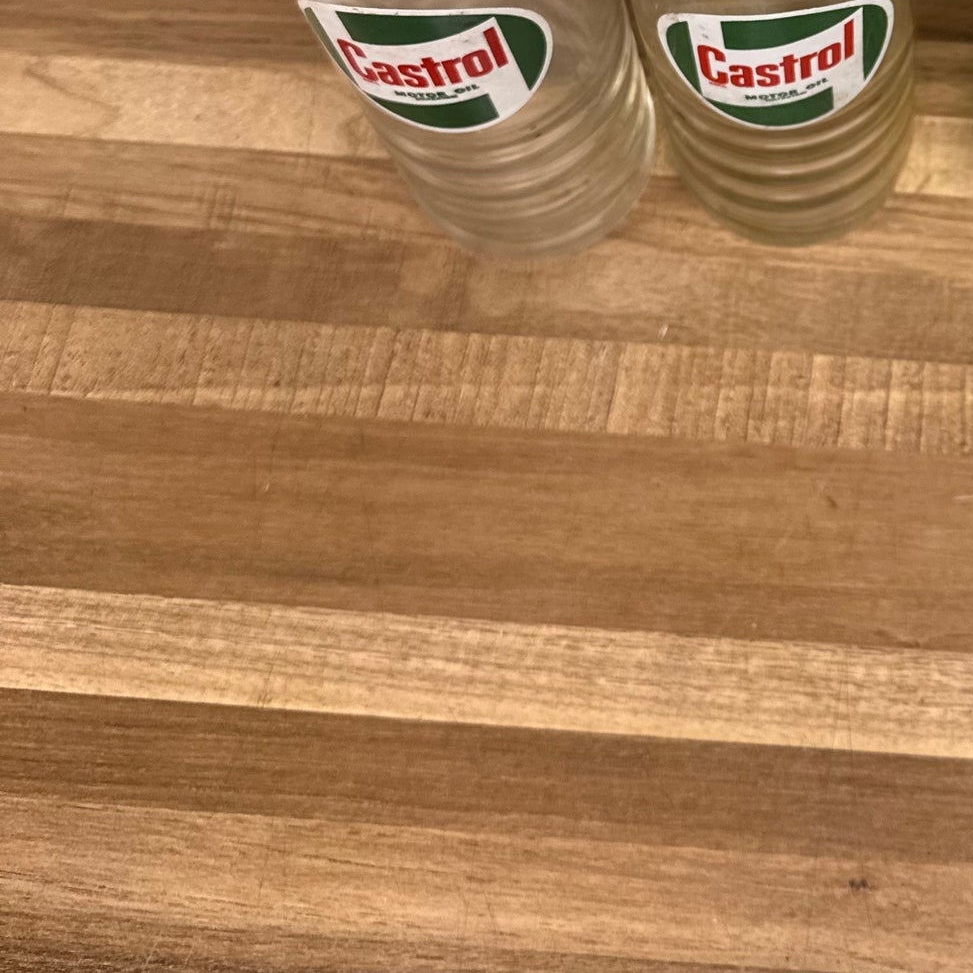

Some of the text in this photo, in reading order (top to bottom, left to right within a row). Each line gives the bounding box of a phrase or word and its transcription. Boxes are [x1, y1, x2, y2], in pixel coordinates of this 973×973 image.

[336, 26, 509, 89] Castrol
[697, 18, 855, 89] Castrol
[393, 89, 447, 100] MOTOR
[454, 83, 481, 94] OIL
[744, 89, 799, 101] MOTOR
[805, 77, 830, 91] OIL
